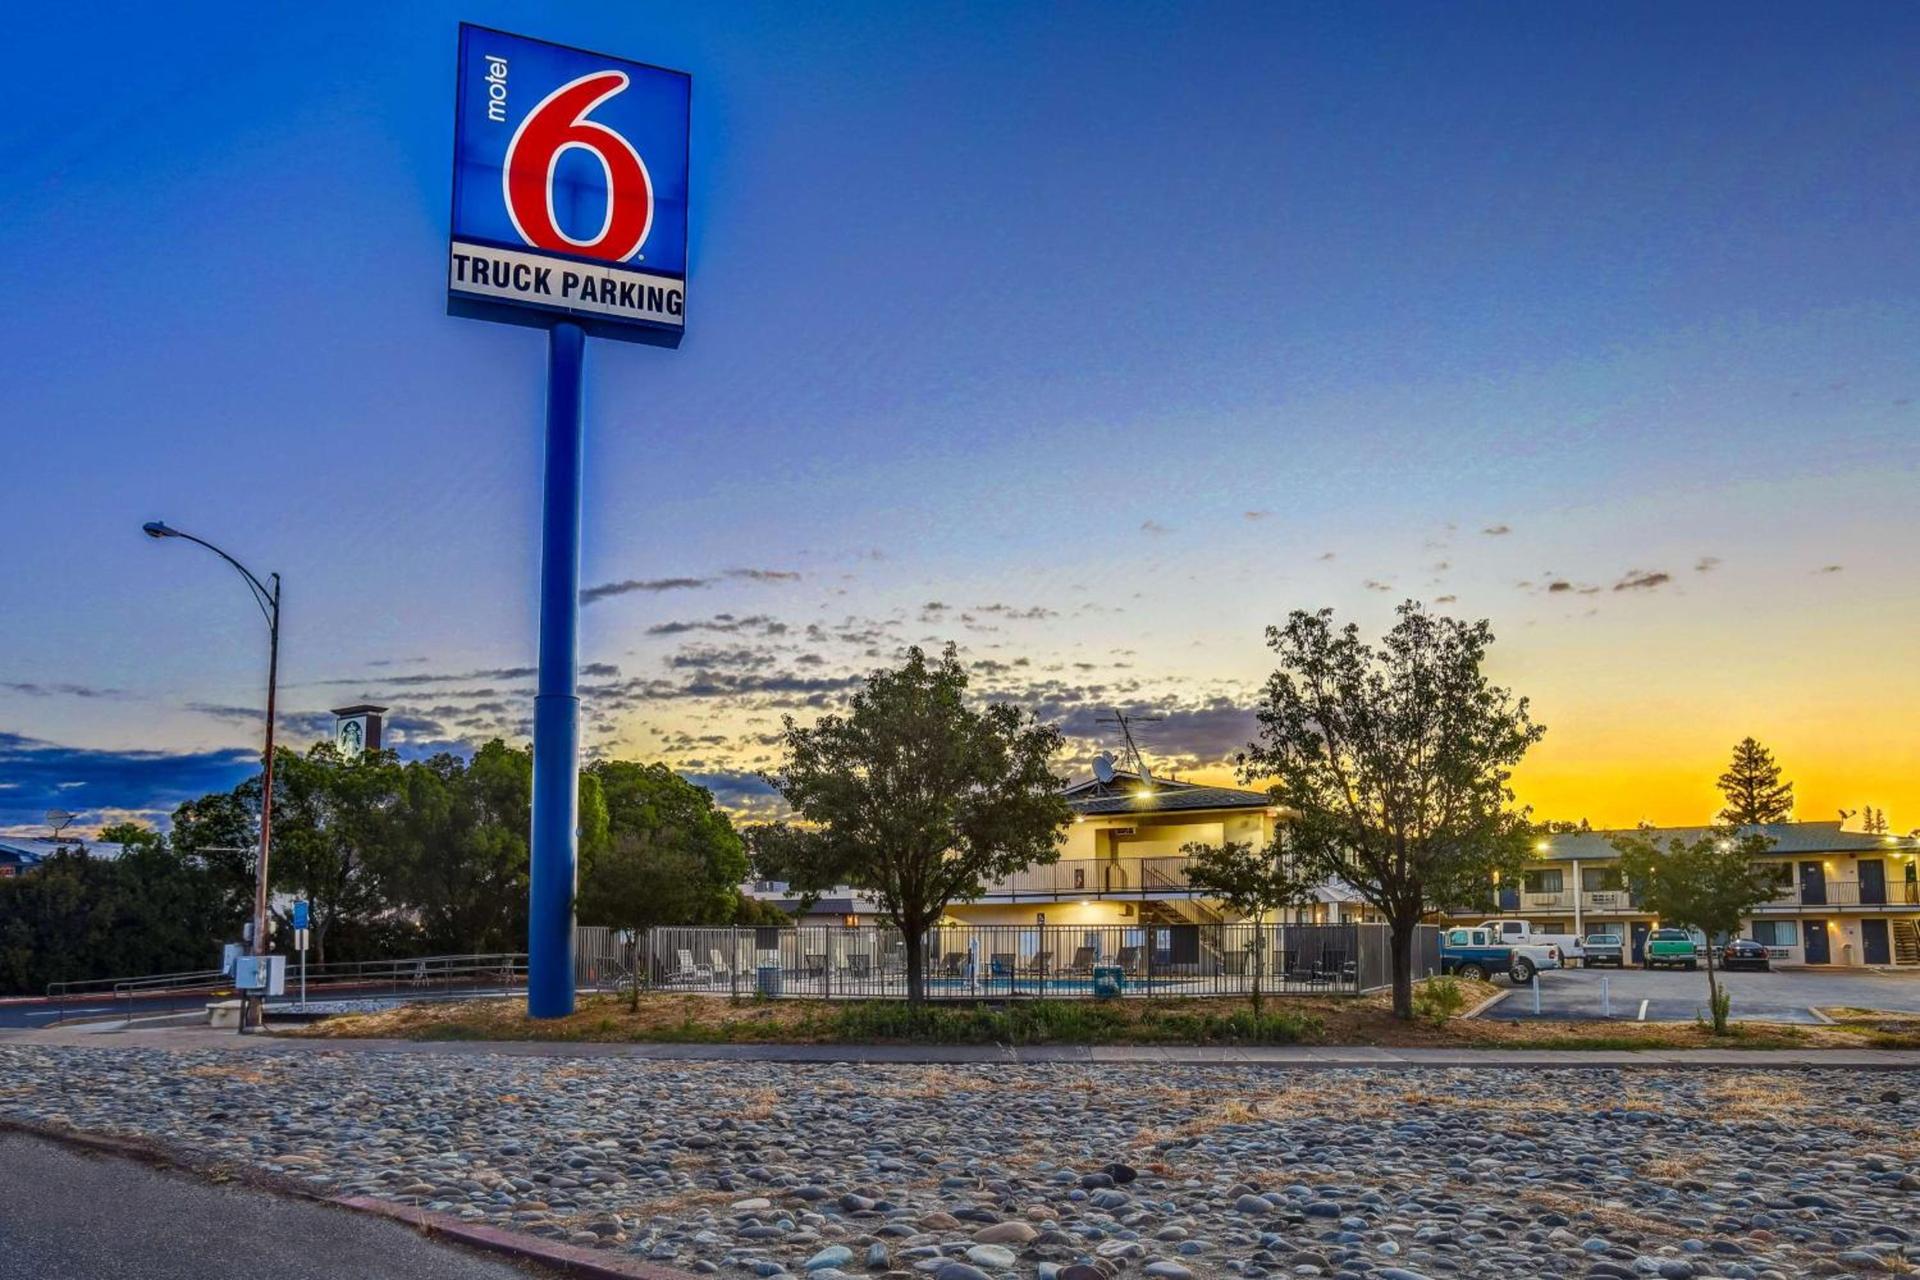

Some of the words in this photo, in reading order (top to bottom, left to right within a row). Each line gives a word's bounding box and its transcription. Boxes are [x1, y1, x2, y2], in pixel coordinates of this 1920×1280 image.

[485, 55, 508, 122] motel
[502, 69, 655, 263] 6
[453, 253, 552, 295] TRUCK
[562, 271, 683, 317] PARKING
